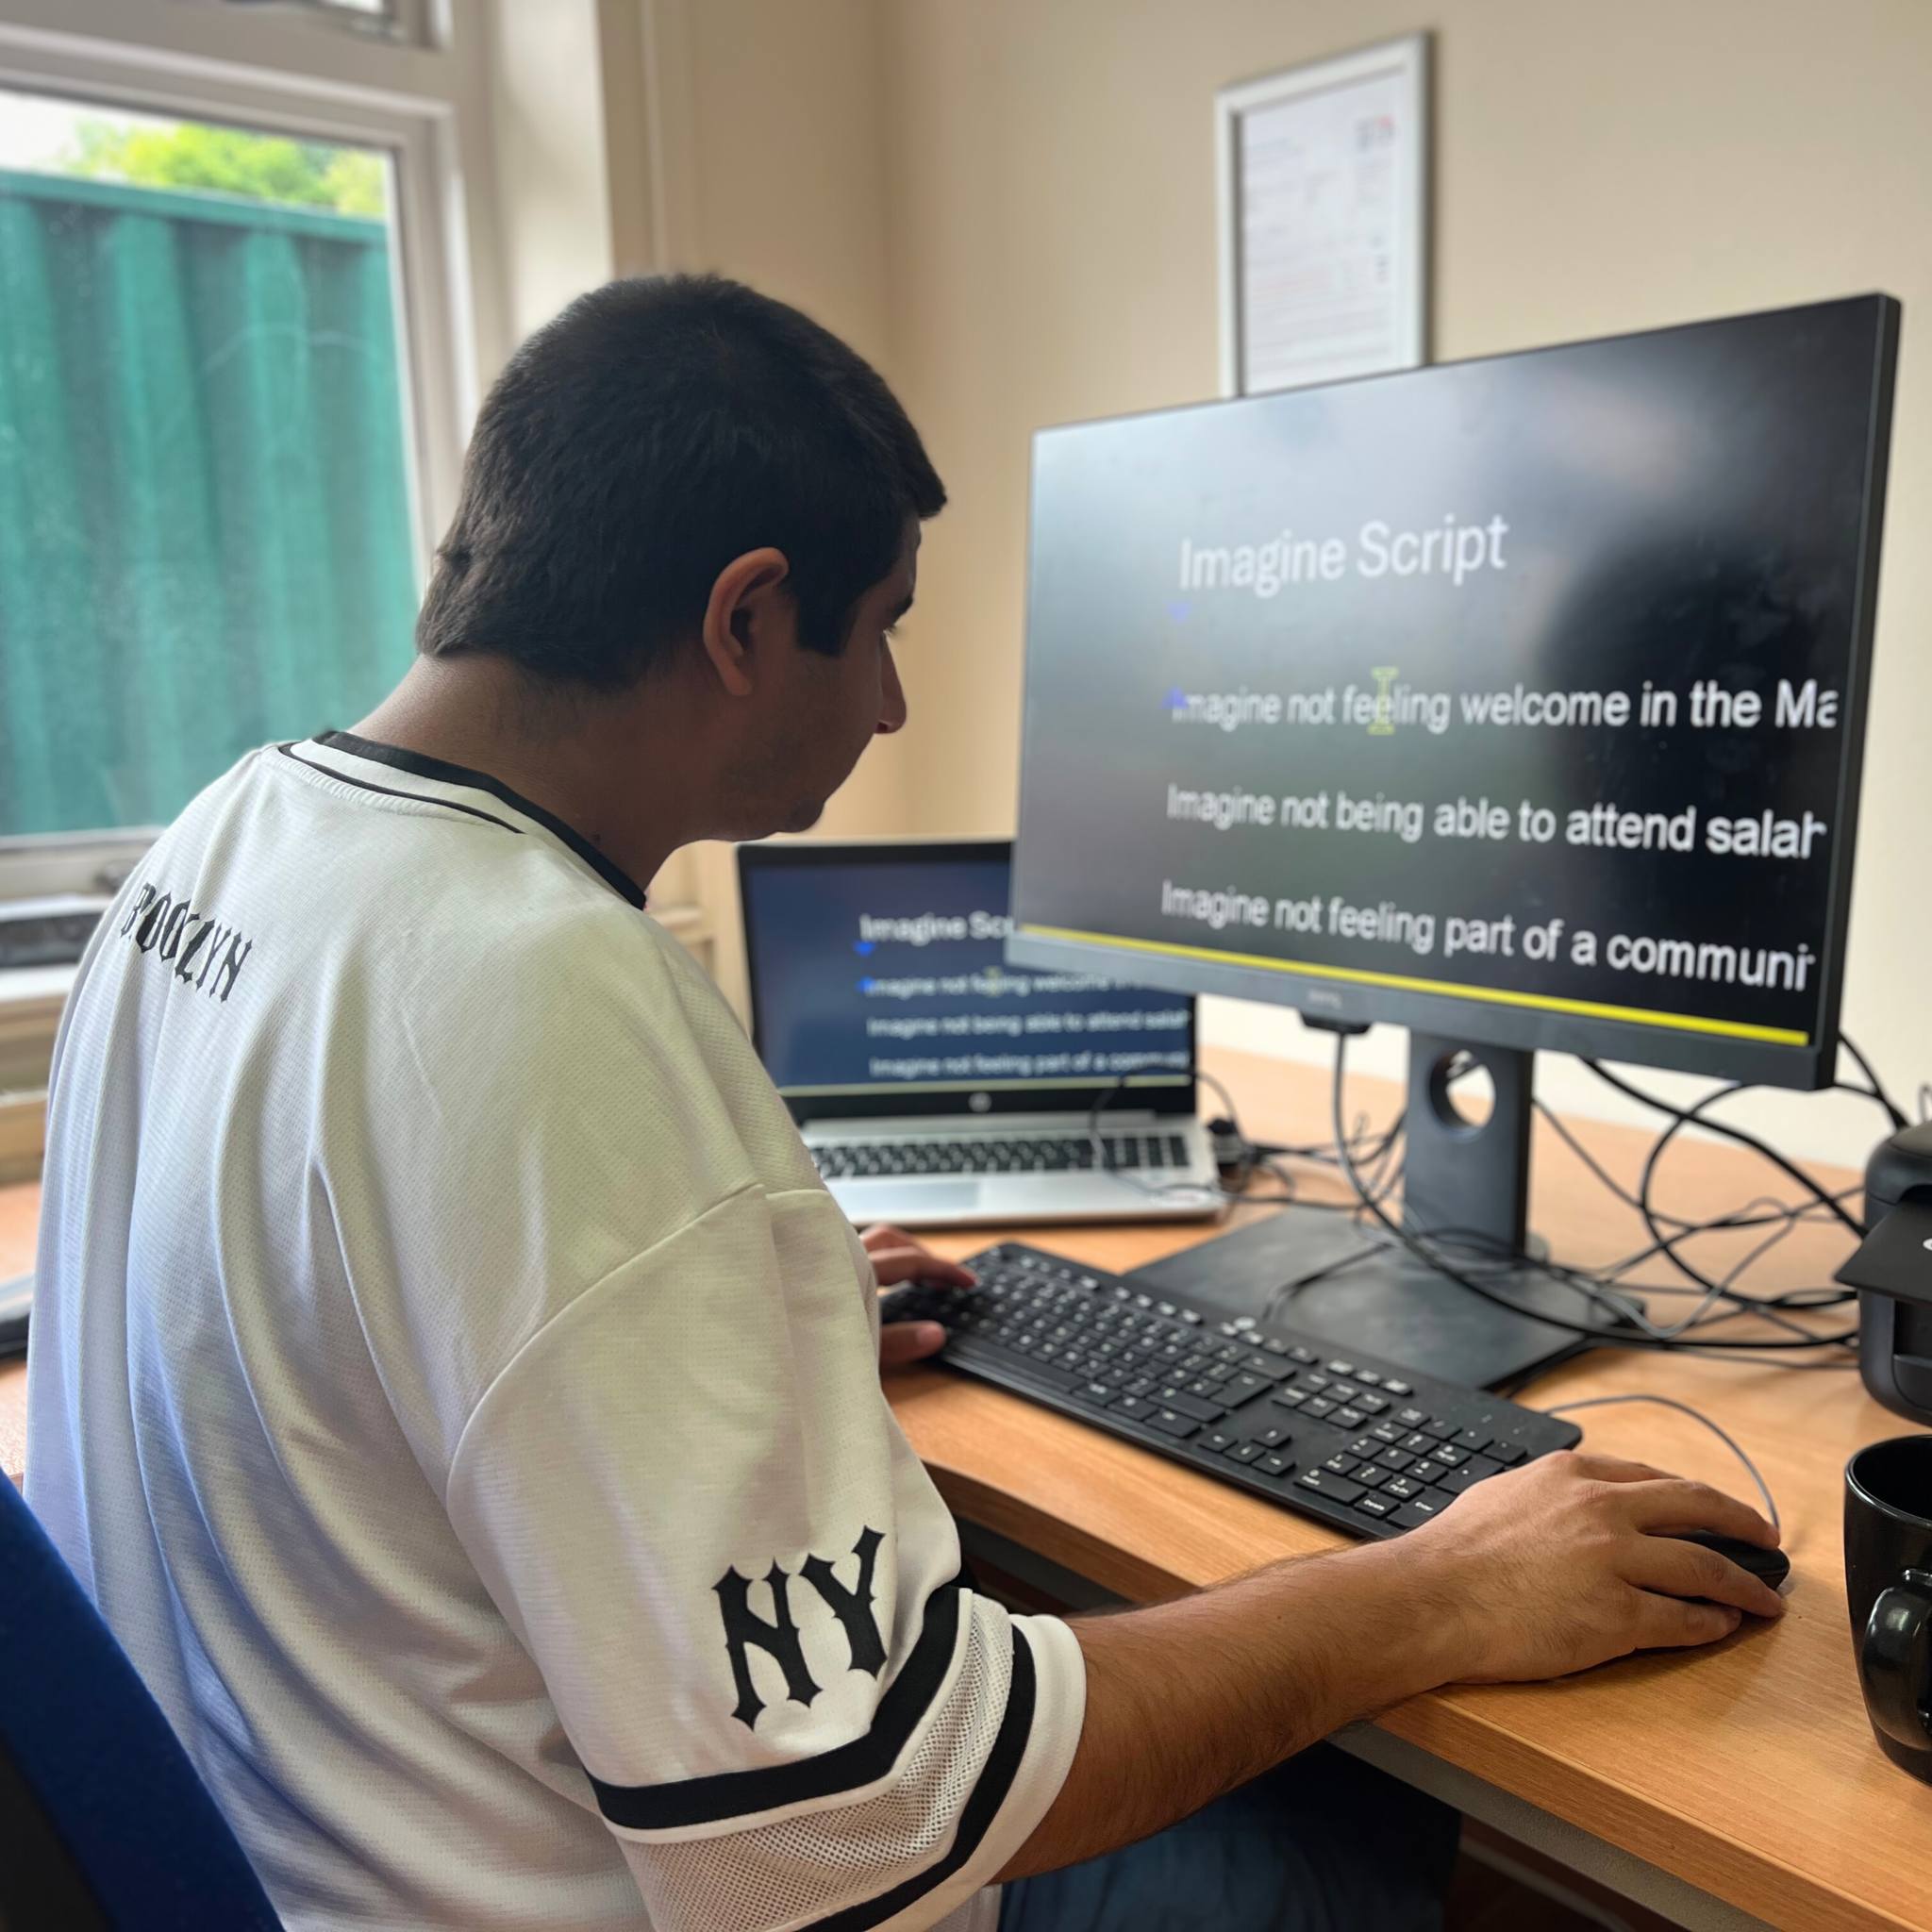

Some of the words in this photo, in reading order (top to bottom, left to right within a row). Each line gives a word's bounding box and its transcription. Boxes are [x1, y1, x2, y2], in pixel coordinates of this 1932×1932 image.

[1180, 536, 1347, 598] Imagine
[1357, 512, 1510, 587] Script
[1286, 686, 1337, 725] not
[1342, 684, 1453, 735] feeling
[1460, 682, 1631, 726] welcome
[1641, 680, 1678, 727] in
[1690, 678, 1762, 727] the
[1166, 782, 1275, 831] Imagine
[1280, 791, 1331, 829] not
[1335, 791, 1425, 842] being
[1433, 795, 1511, 841] able
[1519, 799, 1557, 843] to
[1565, 802, 1697, 852] attend
[859, 911, 968, 947] Imagine
[1161, 878, 1271, 929] Imagine
[1274, 895, 1323, 934] not
[1327, 895, 1436, 955] feeling
[1442, 913, 1516, 958] part
[1522, 918, 1565, 961] of
[1570, 929, 1597, 967] a
[1606, 934, 1816, 992] communi
[711, 1524, 888, 1731] NY
